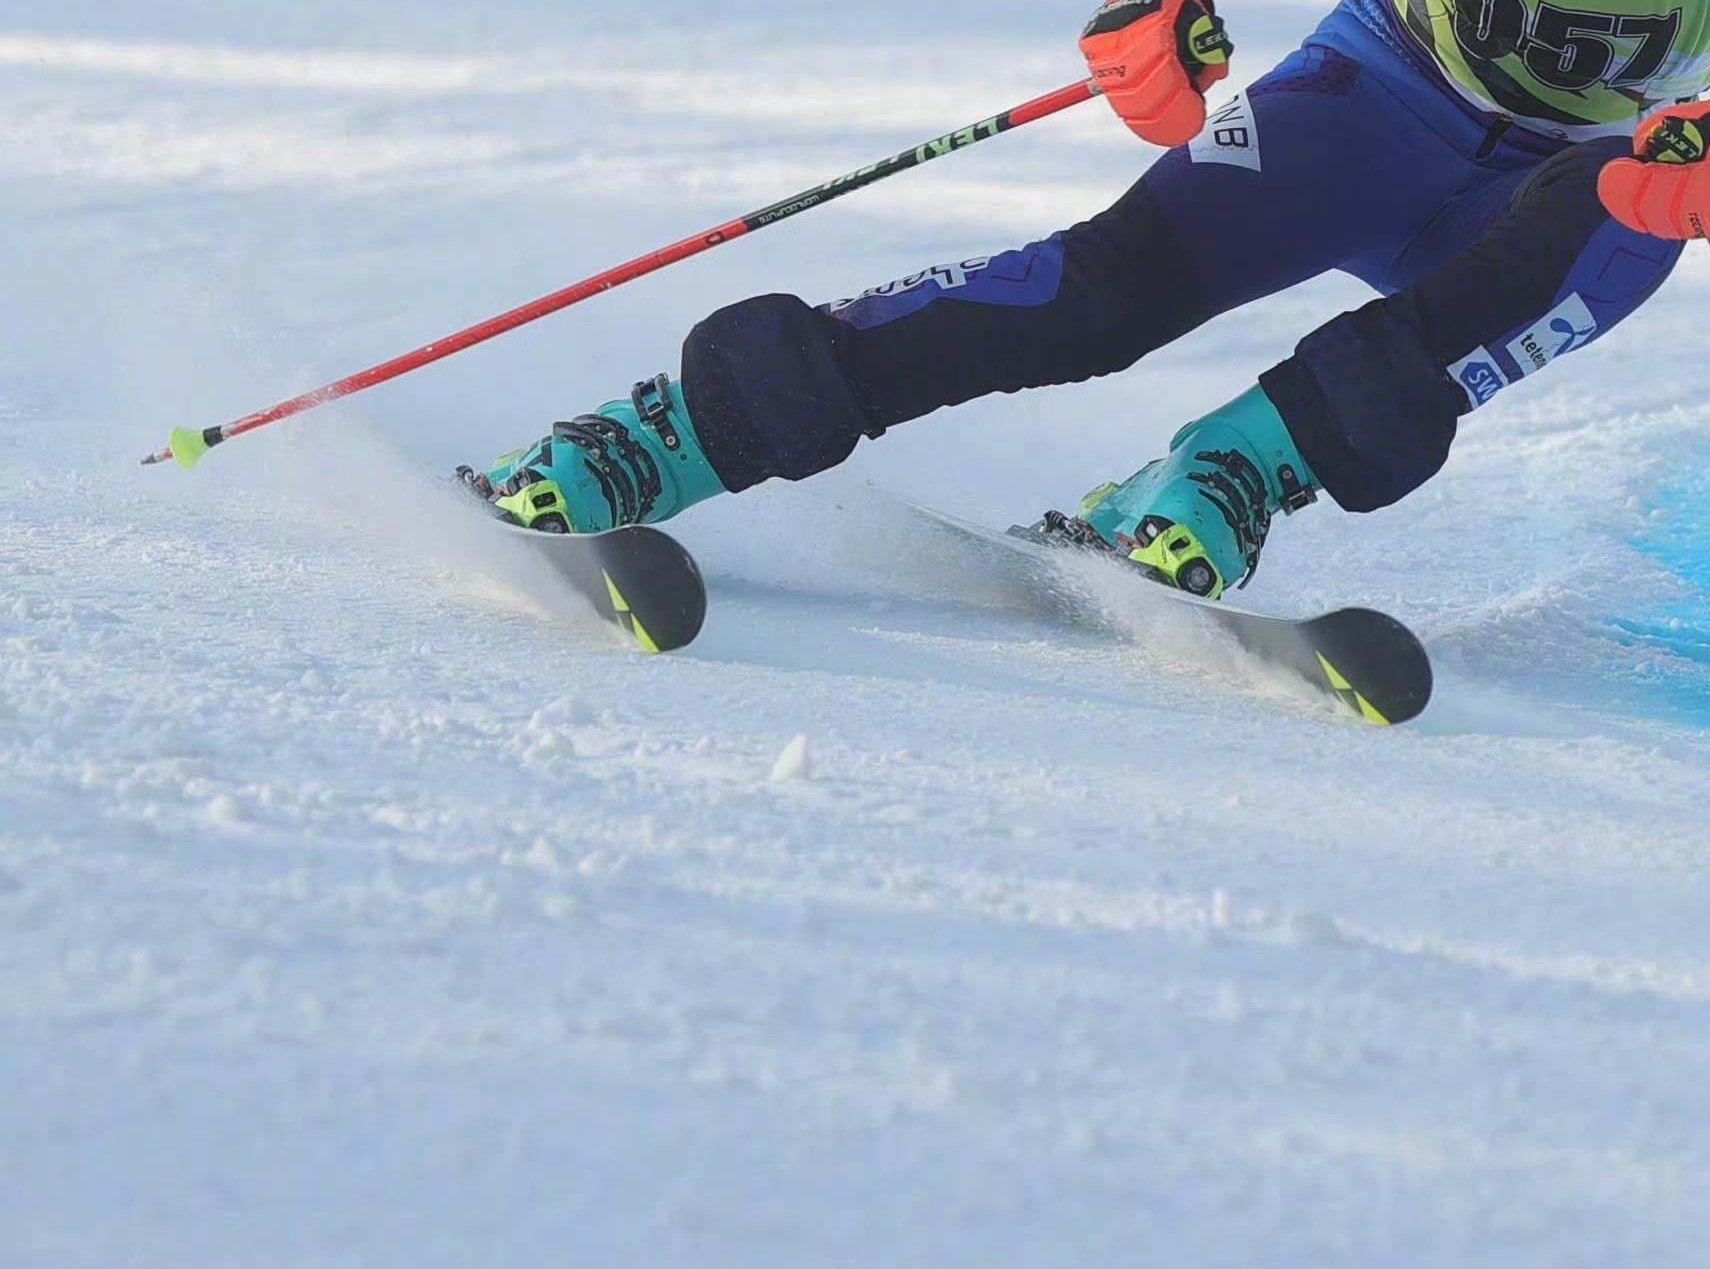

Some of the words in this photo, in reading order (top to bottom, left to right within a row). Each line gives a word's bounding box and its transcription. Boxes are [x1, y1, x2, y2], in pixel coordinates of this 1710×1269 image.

[916, 116, 1000, 164] LEKI
[1205, 94, 1248, 148] NB
[1659, 130, 1697, 159] LEKI
